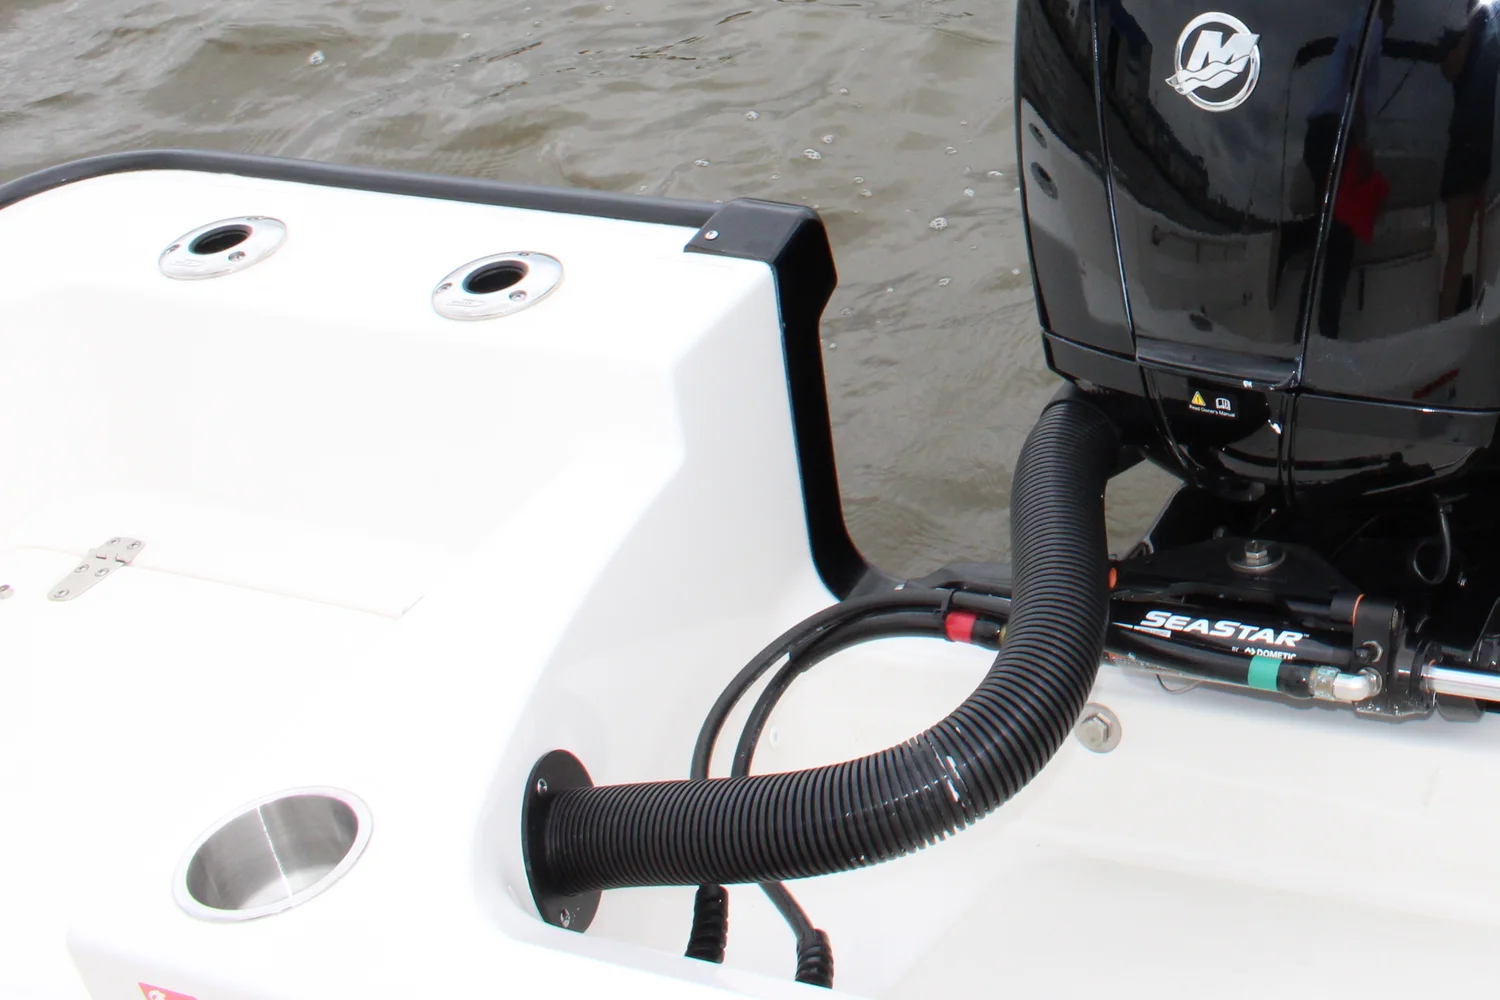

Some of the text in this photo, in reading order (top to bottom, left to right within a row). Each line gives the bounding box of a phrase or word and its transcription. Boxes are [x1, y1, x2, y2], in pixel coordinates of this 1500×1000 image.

[1188, 403, 1201, 412] Read
[1218, 410, 1236, 418] Manual
[1139, 610, 1304, 648] SEASTAR
